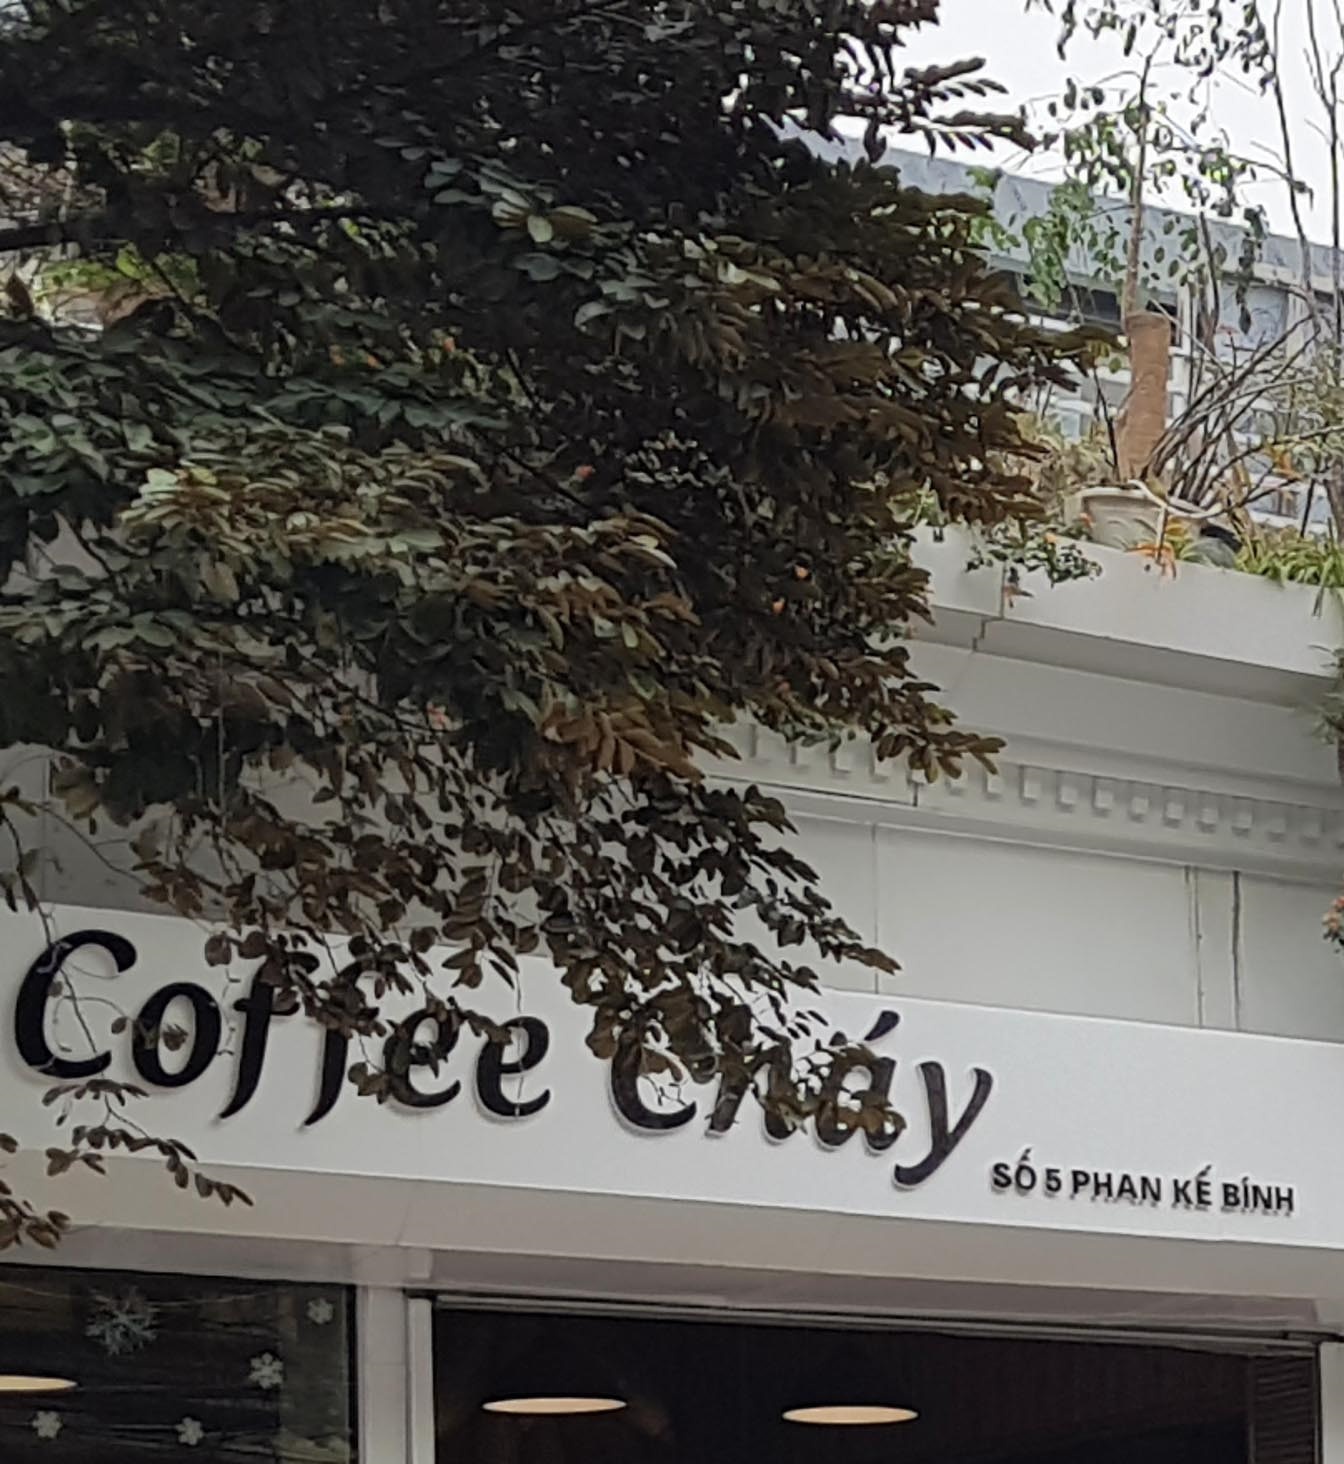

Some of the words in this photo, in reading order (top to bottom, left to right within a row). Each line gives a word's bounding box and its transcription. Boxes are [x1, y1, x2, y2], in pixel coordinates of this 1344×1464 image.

[992, 1147, 1037, 1190] SỐ
[1044, 1168, 1062, 1193] 5
[1069, 1169, 1162, 1203] PHAN
[1173, 1164, 1214, 1207] KẾ
[1220, 1176, 1295, 1213] BÍNH
